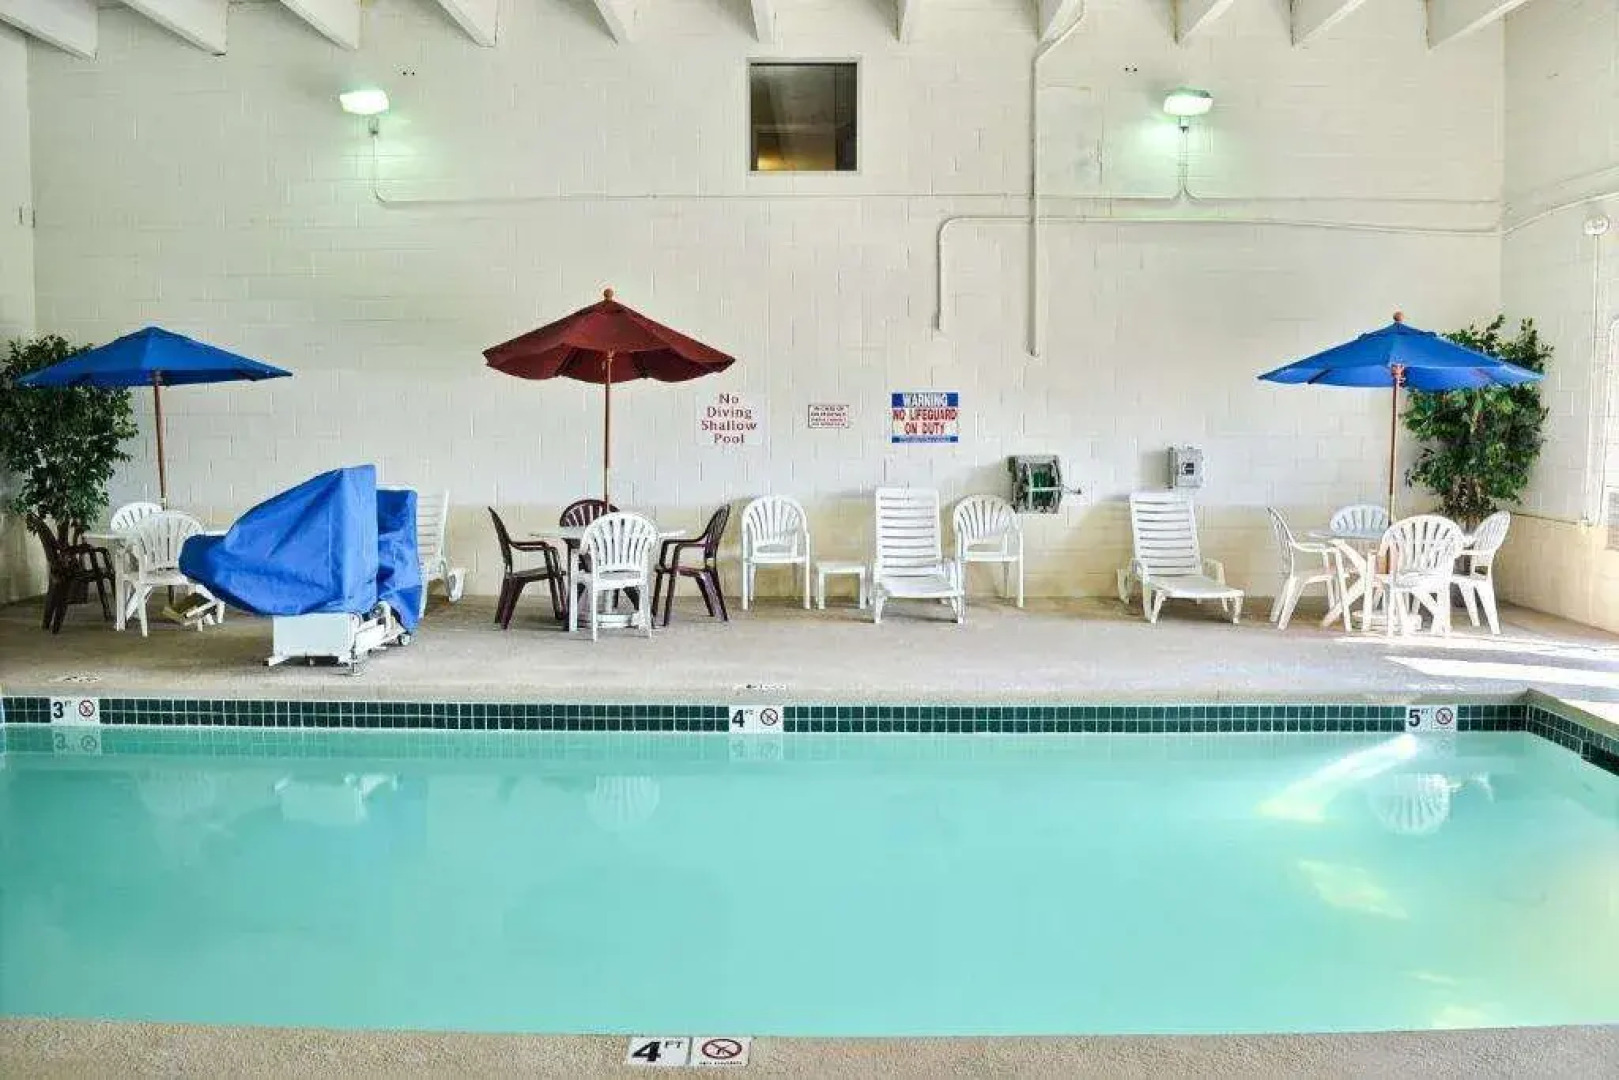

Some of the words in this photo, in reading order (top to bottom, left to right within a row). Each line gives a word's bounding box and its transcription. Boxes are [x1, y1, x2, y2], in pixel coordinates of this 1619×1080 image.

[719, 393, 739, 404] No
[707, 406, 752, 420] Diving
[892, 409, 906, 420] NO
[909, 409, 957, 420] LIFEGUARD
[701, 420, 757, 431] Shallow
[905, 422, 918, 435] ON
[922, 422, 945, 434] DUTY
[714, 433, 744, 444] Pool
[53, 701, 64, 719] 3
[731, 709, 745, 728] 4
[1409, 709, 1421, 727] 5
[632, 1041, 662, 1062] 4
